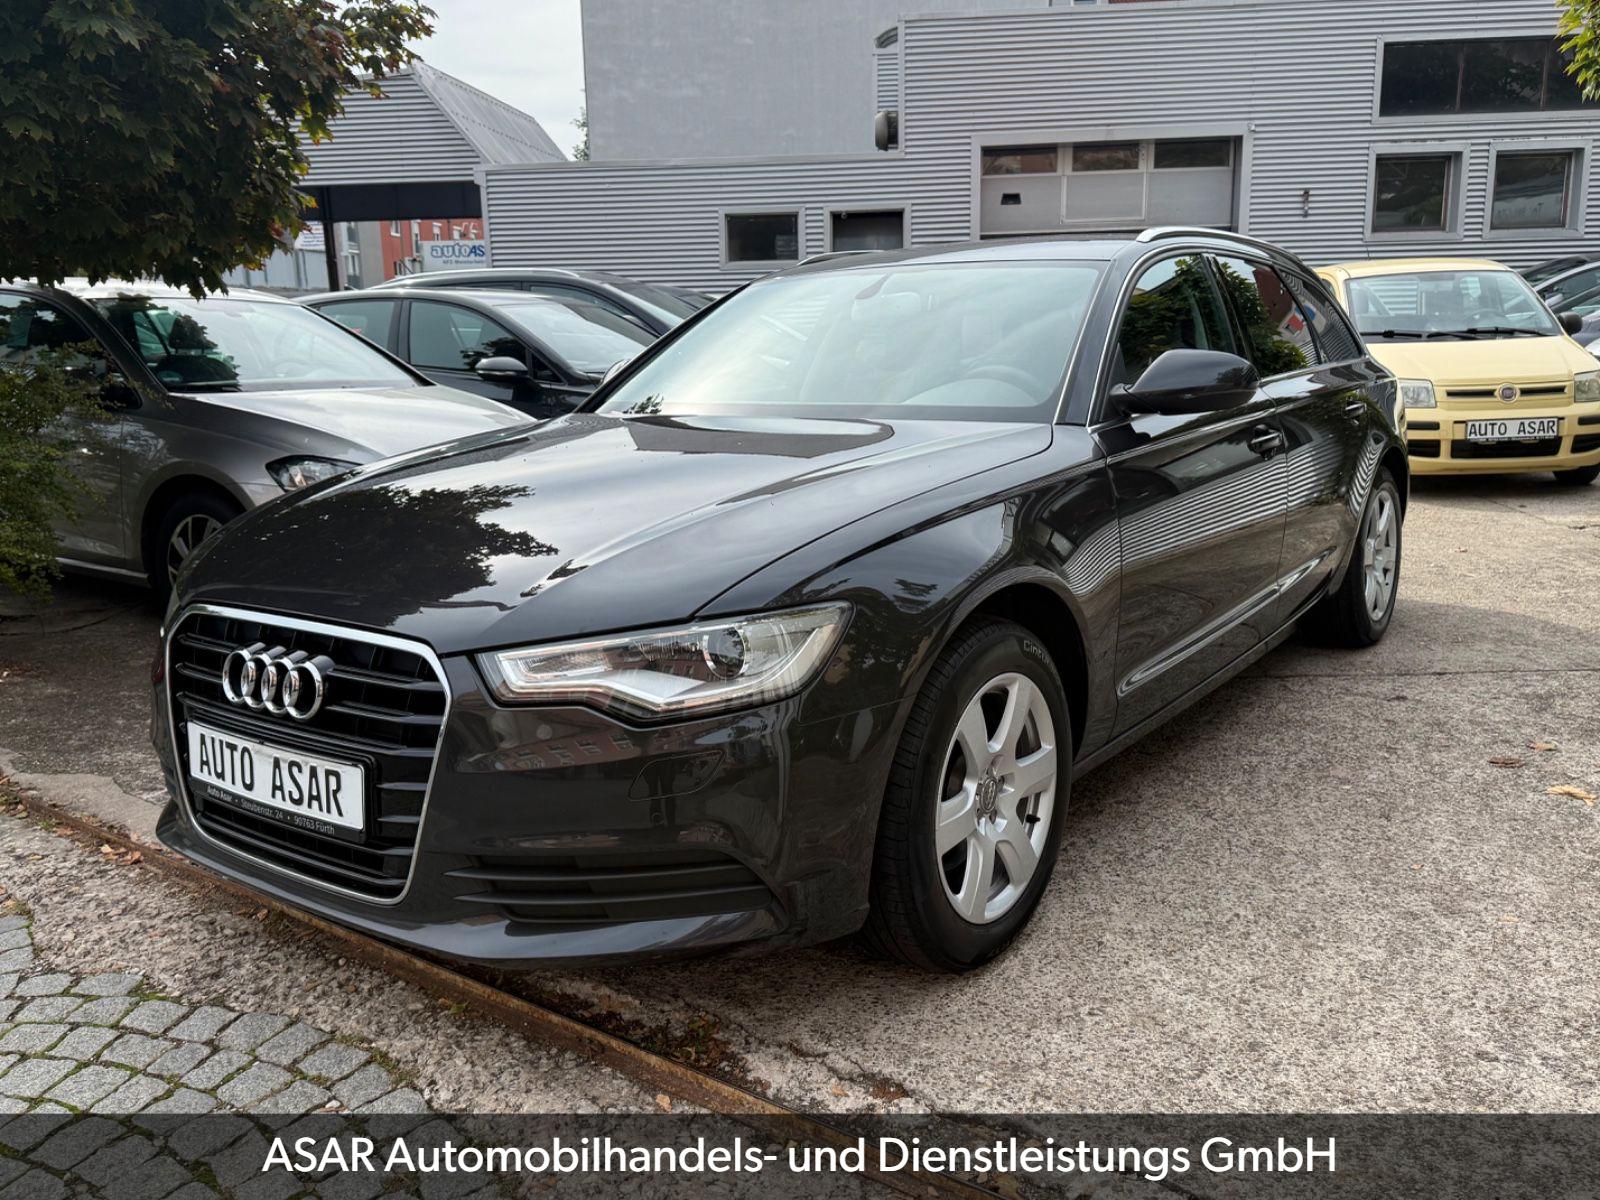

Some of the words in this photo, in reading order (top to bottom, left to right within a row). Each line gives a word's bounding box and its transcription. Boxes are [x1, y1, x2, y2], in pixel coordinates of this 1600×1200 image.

[1468, 422, 1508, 437] AUTO
[1517, 420, 1556, 435] ASAR
[199, 733, 254, 792] AUTO
[271, 756, 344, 817] ASAR
[206, 785, 220, 798] Auto
[219, 789, 233, 802] Asar
[275, 810, 284, 820] 24
[294, 815, 315, 830] 90763
[315, 820, 335, 836] Fürth
